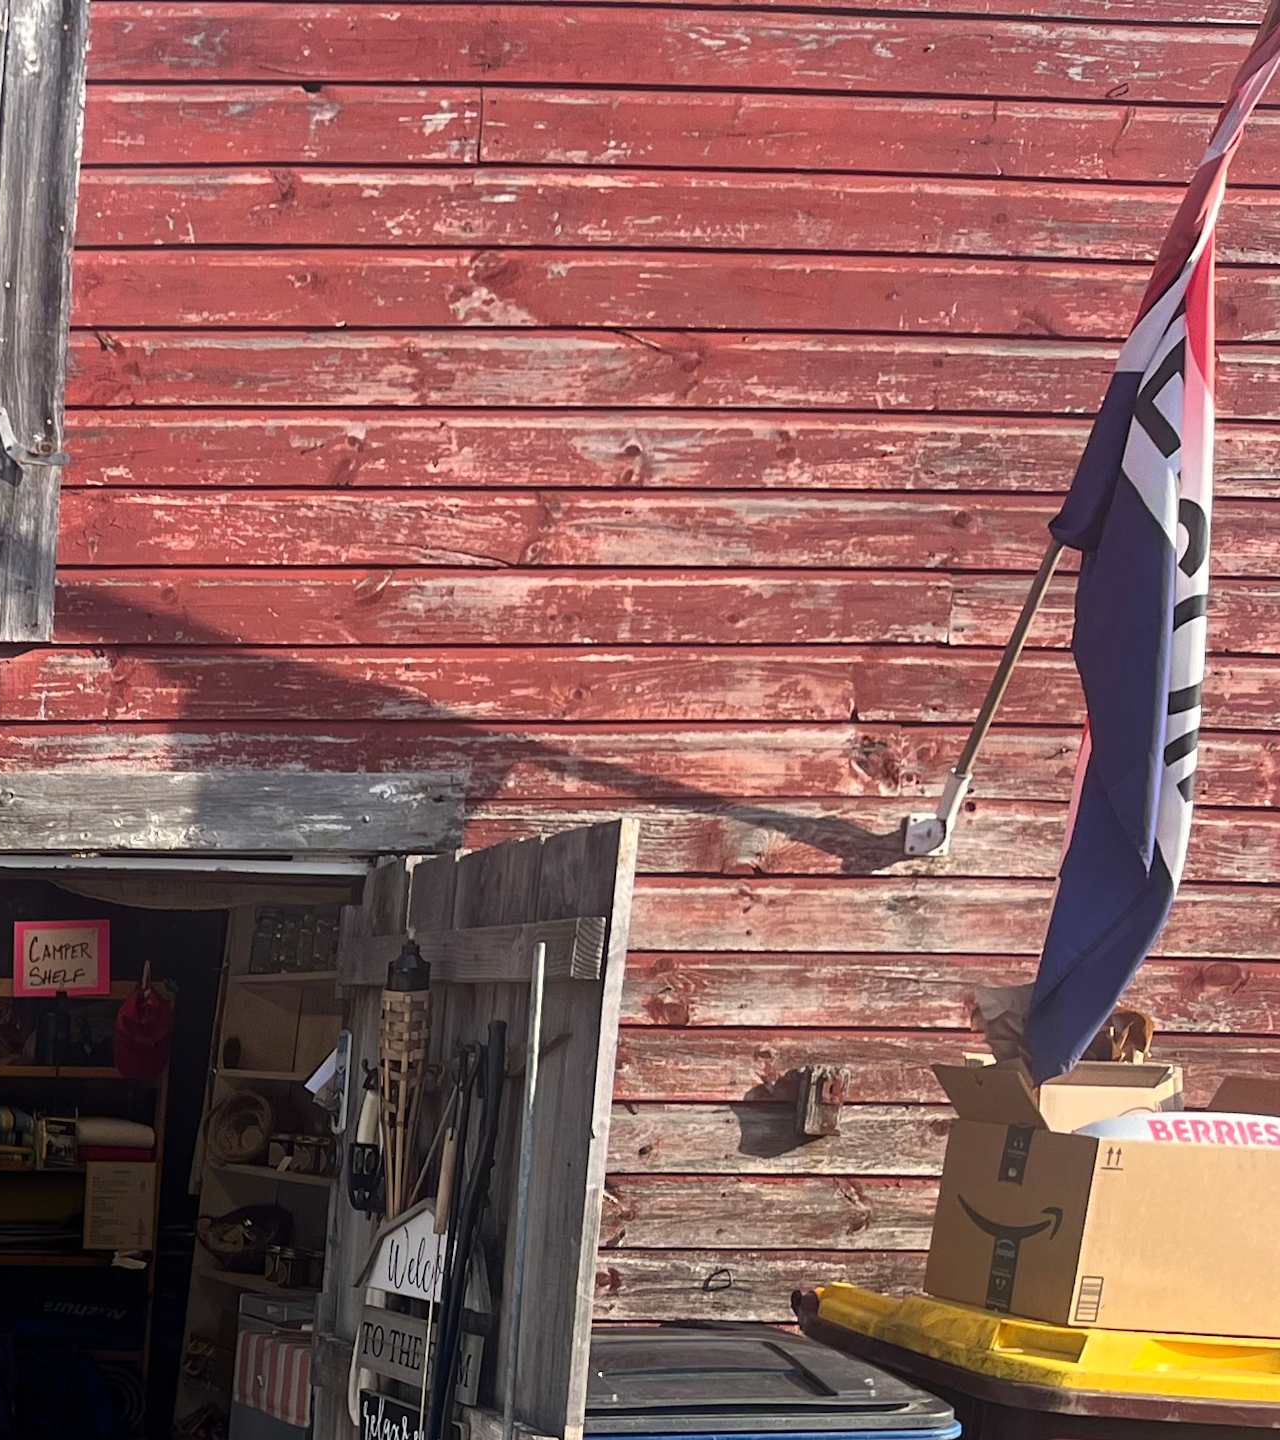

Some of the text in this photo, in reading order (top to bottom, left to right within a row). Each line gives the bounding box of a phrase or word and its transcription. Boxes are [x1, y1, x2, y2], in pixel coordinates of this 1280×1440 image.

[29, 966, 86, 986] SHELF
[1147, 1119, 1280, 1146] BERRIES
[362, 1322, 384, 1358] TO
[390, 1331, 422, 1371] THE
